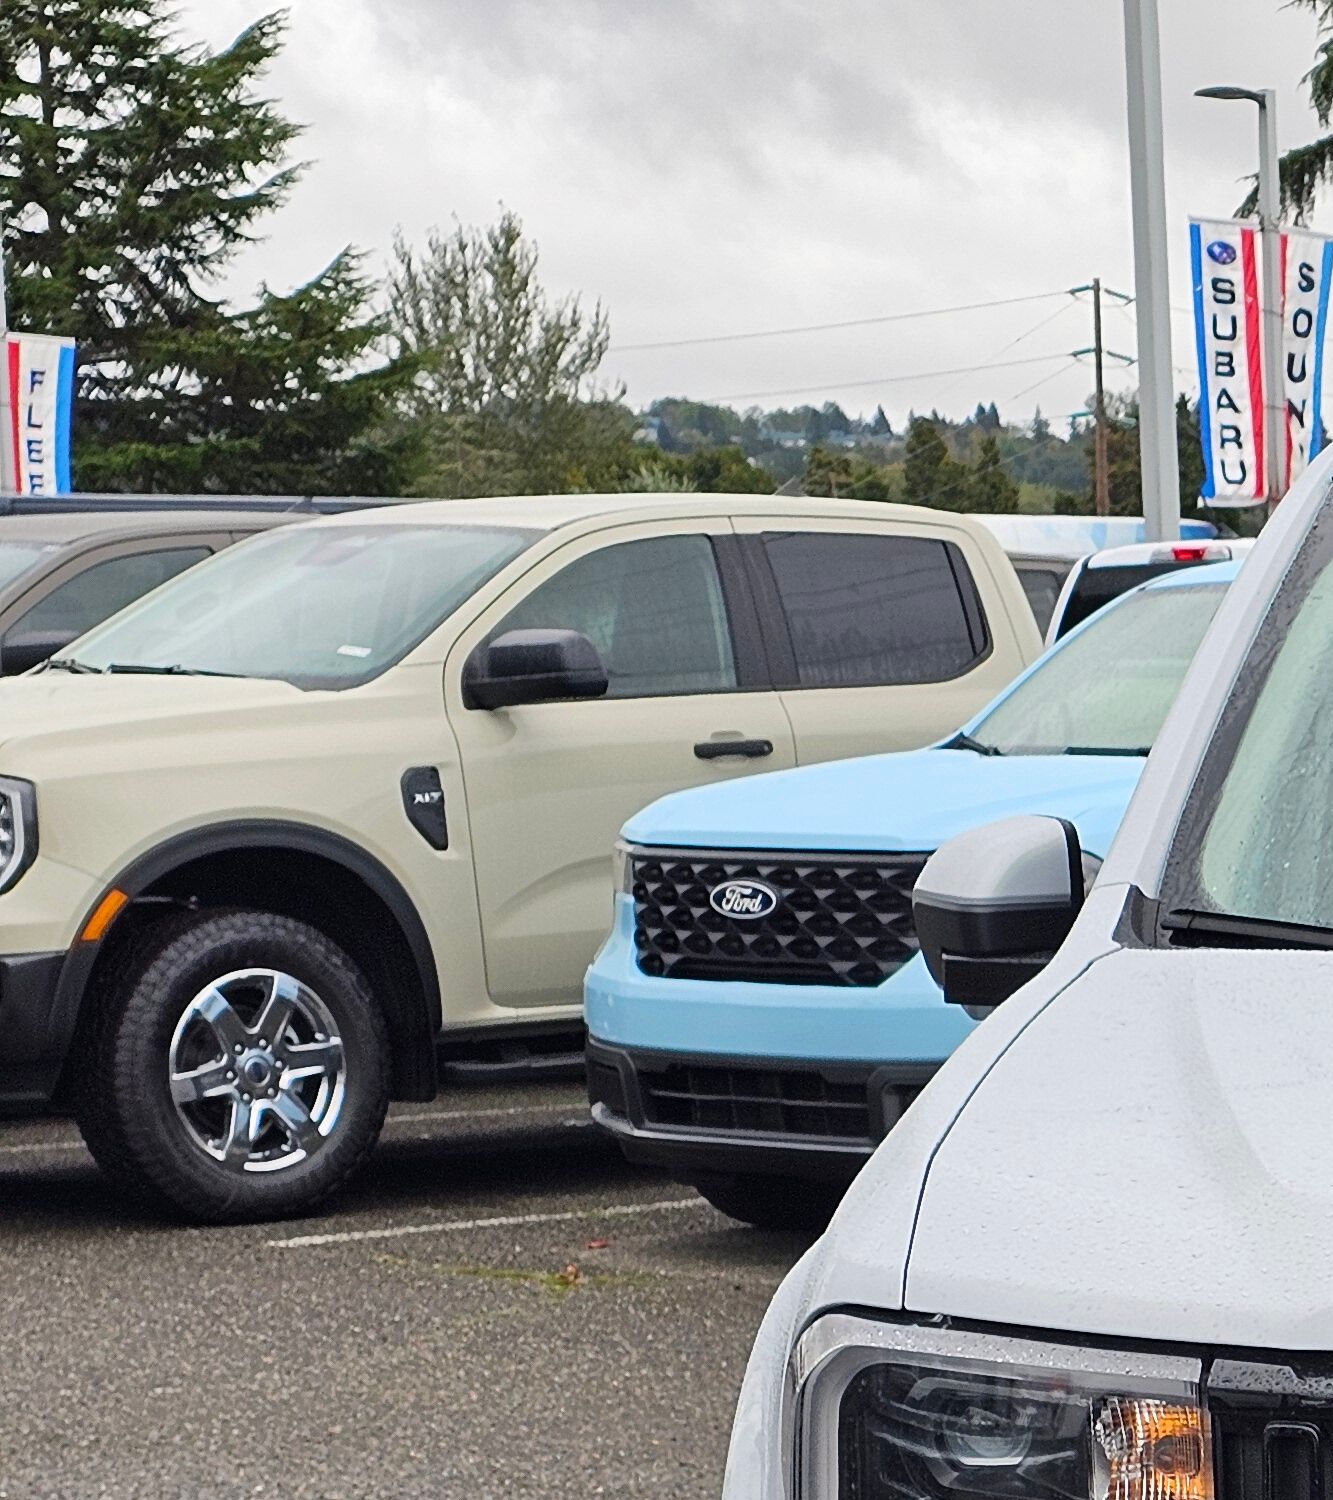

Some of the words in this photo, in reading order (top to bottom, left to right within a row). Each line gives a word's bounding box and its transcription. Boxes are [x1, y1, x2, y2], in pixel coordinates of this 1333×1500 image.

[1211, 277, 1247, 485] SUBARU
[1286, 262, 1315, 456] SOUN
[721, 885, 763, 913] Ford
